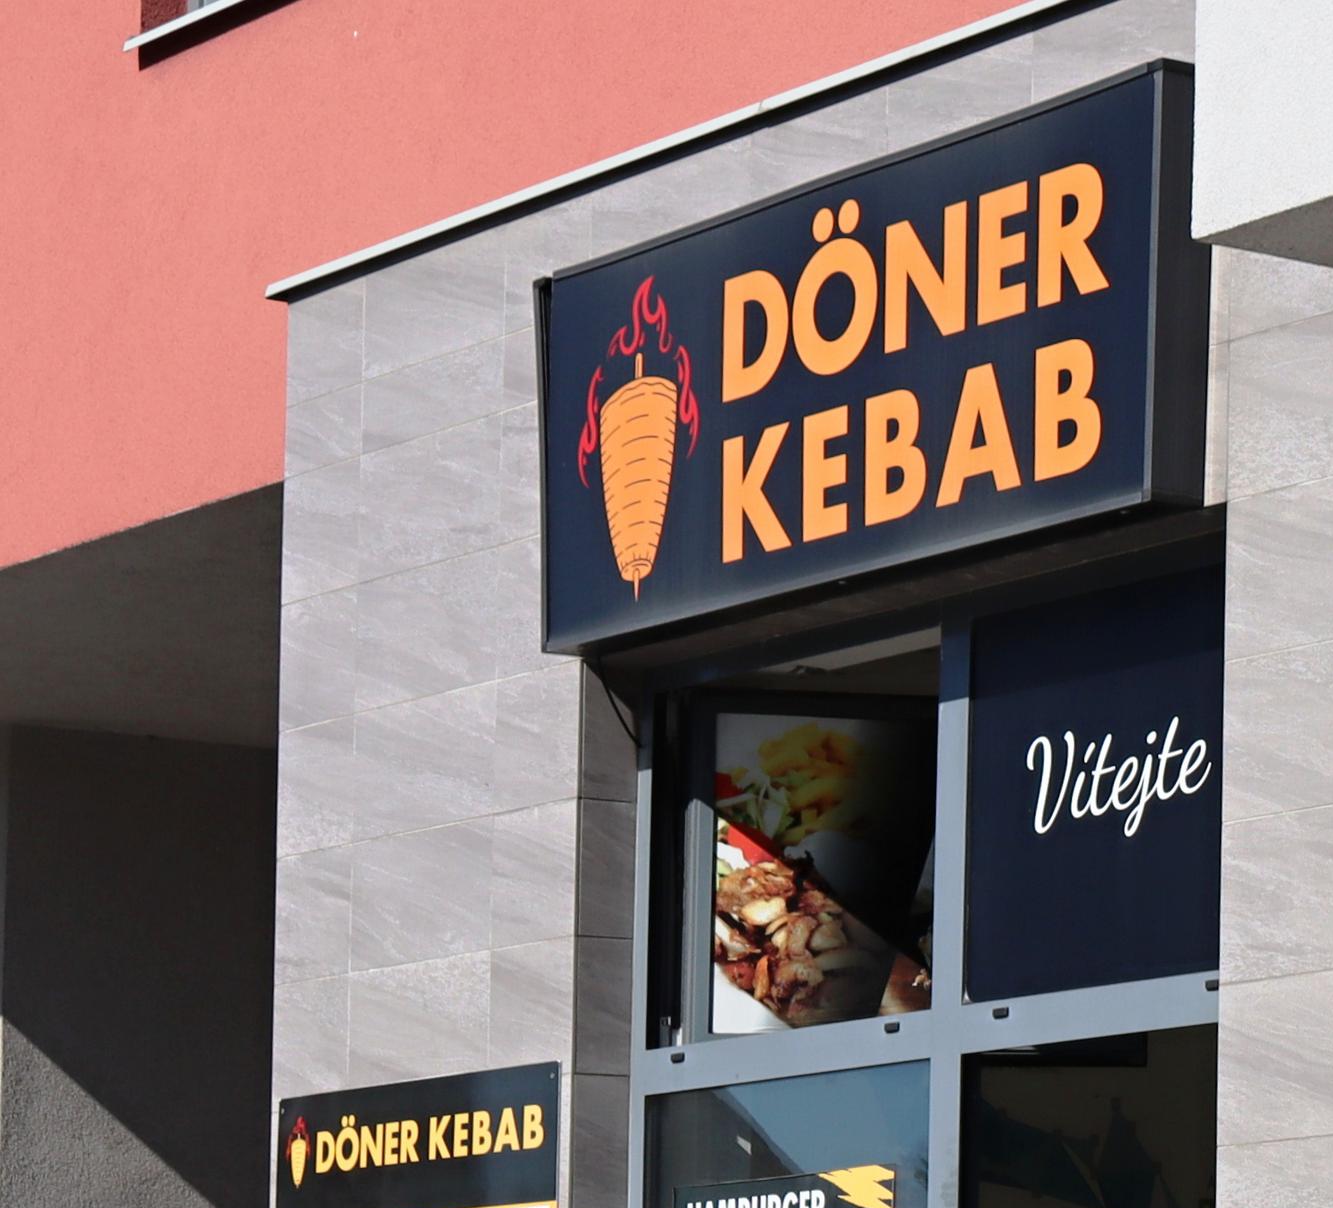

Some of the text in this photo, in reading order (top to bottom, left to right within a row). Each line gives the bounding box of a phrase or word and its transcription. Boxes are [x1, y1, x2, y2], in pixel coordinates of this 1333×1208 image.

[721, 162, 1110, 403] DÖNER
[721, 337, 1102, 565] KEBAB
[1025, 716, 1212, 838] Vítejte
[315, 1104, 545, 1174] DÖNER KEBAB
